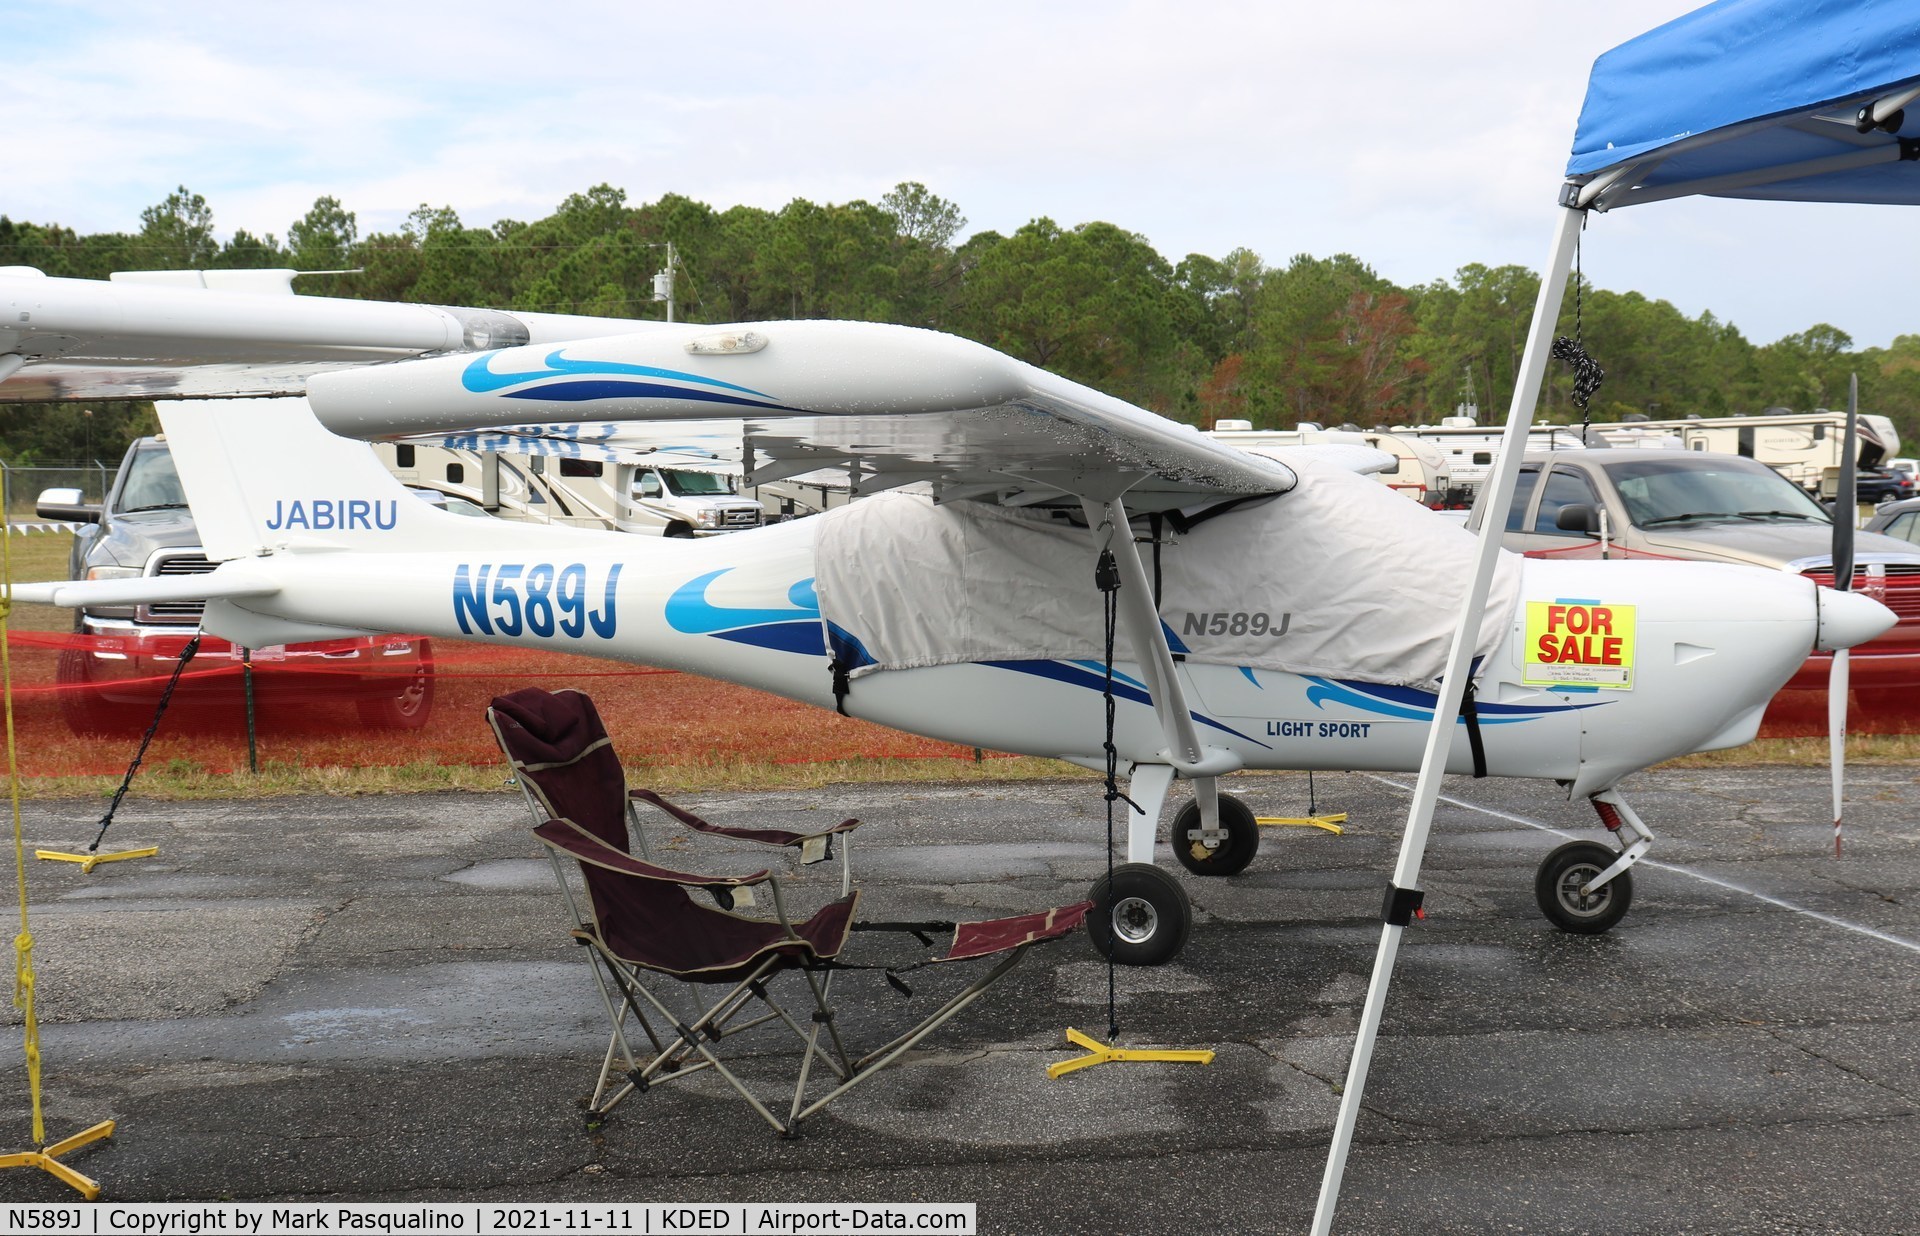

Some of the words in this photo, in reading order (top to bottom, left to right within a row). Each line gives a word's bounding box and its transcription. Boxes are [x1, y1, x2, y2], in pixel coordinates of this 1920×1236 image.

[266, 500, 397, 530] JABIRU
[453, 563, 623, 639] N589J
[1183, 612, 1291, 636] N589J
[1548, 605, 1613, 635] FOR
[1537, 634, 1623, 665] SALE
[1267, 721, 1313, 737] LIGHT
[1319, 722, 1371, 738] SPORT
